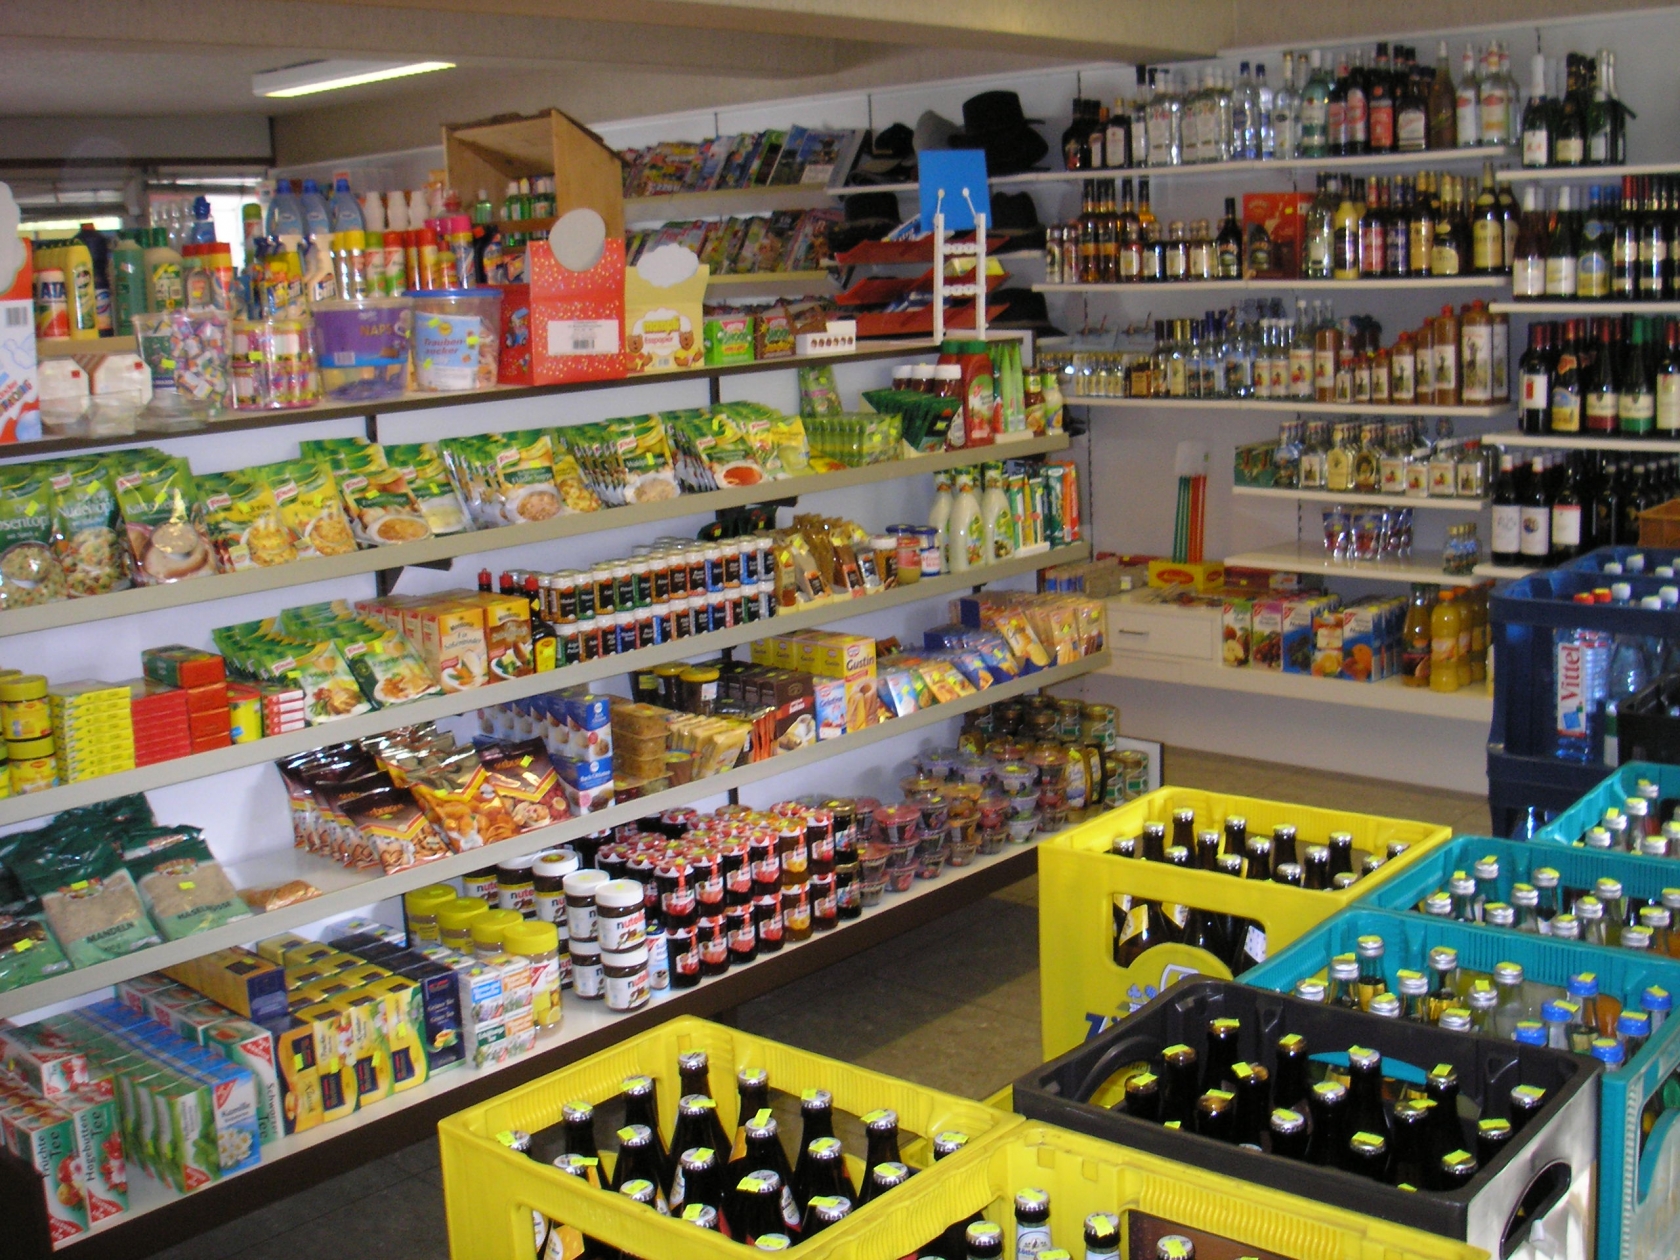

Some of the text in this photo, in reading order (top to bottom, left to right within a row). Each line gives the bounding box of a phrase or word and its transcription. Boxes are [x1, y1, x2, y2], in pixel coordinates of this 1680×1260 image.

[423, 338, 466, 347] Trauben-
[846, 655, 875, 671] Gustin
[1559, 645, 1581, 704] Vittel
[86, 921, 135, 943] MANDELN
[267, 1082, 278, 1135] Schwarzer
[91, 1111, 103, 1137] Tee
[258, 1116, 269, 1139] Tee
[50, 1131, 61, 1158] Tee
[81, 1114, 96, 1182] Hagebutten
